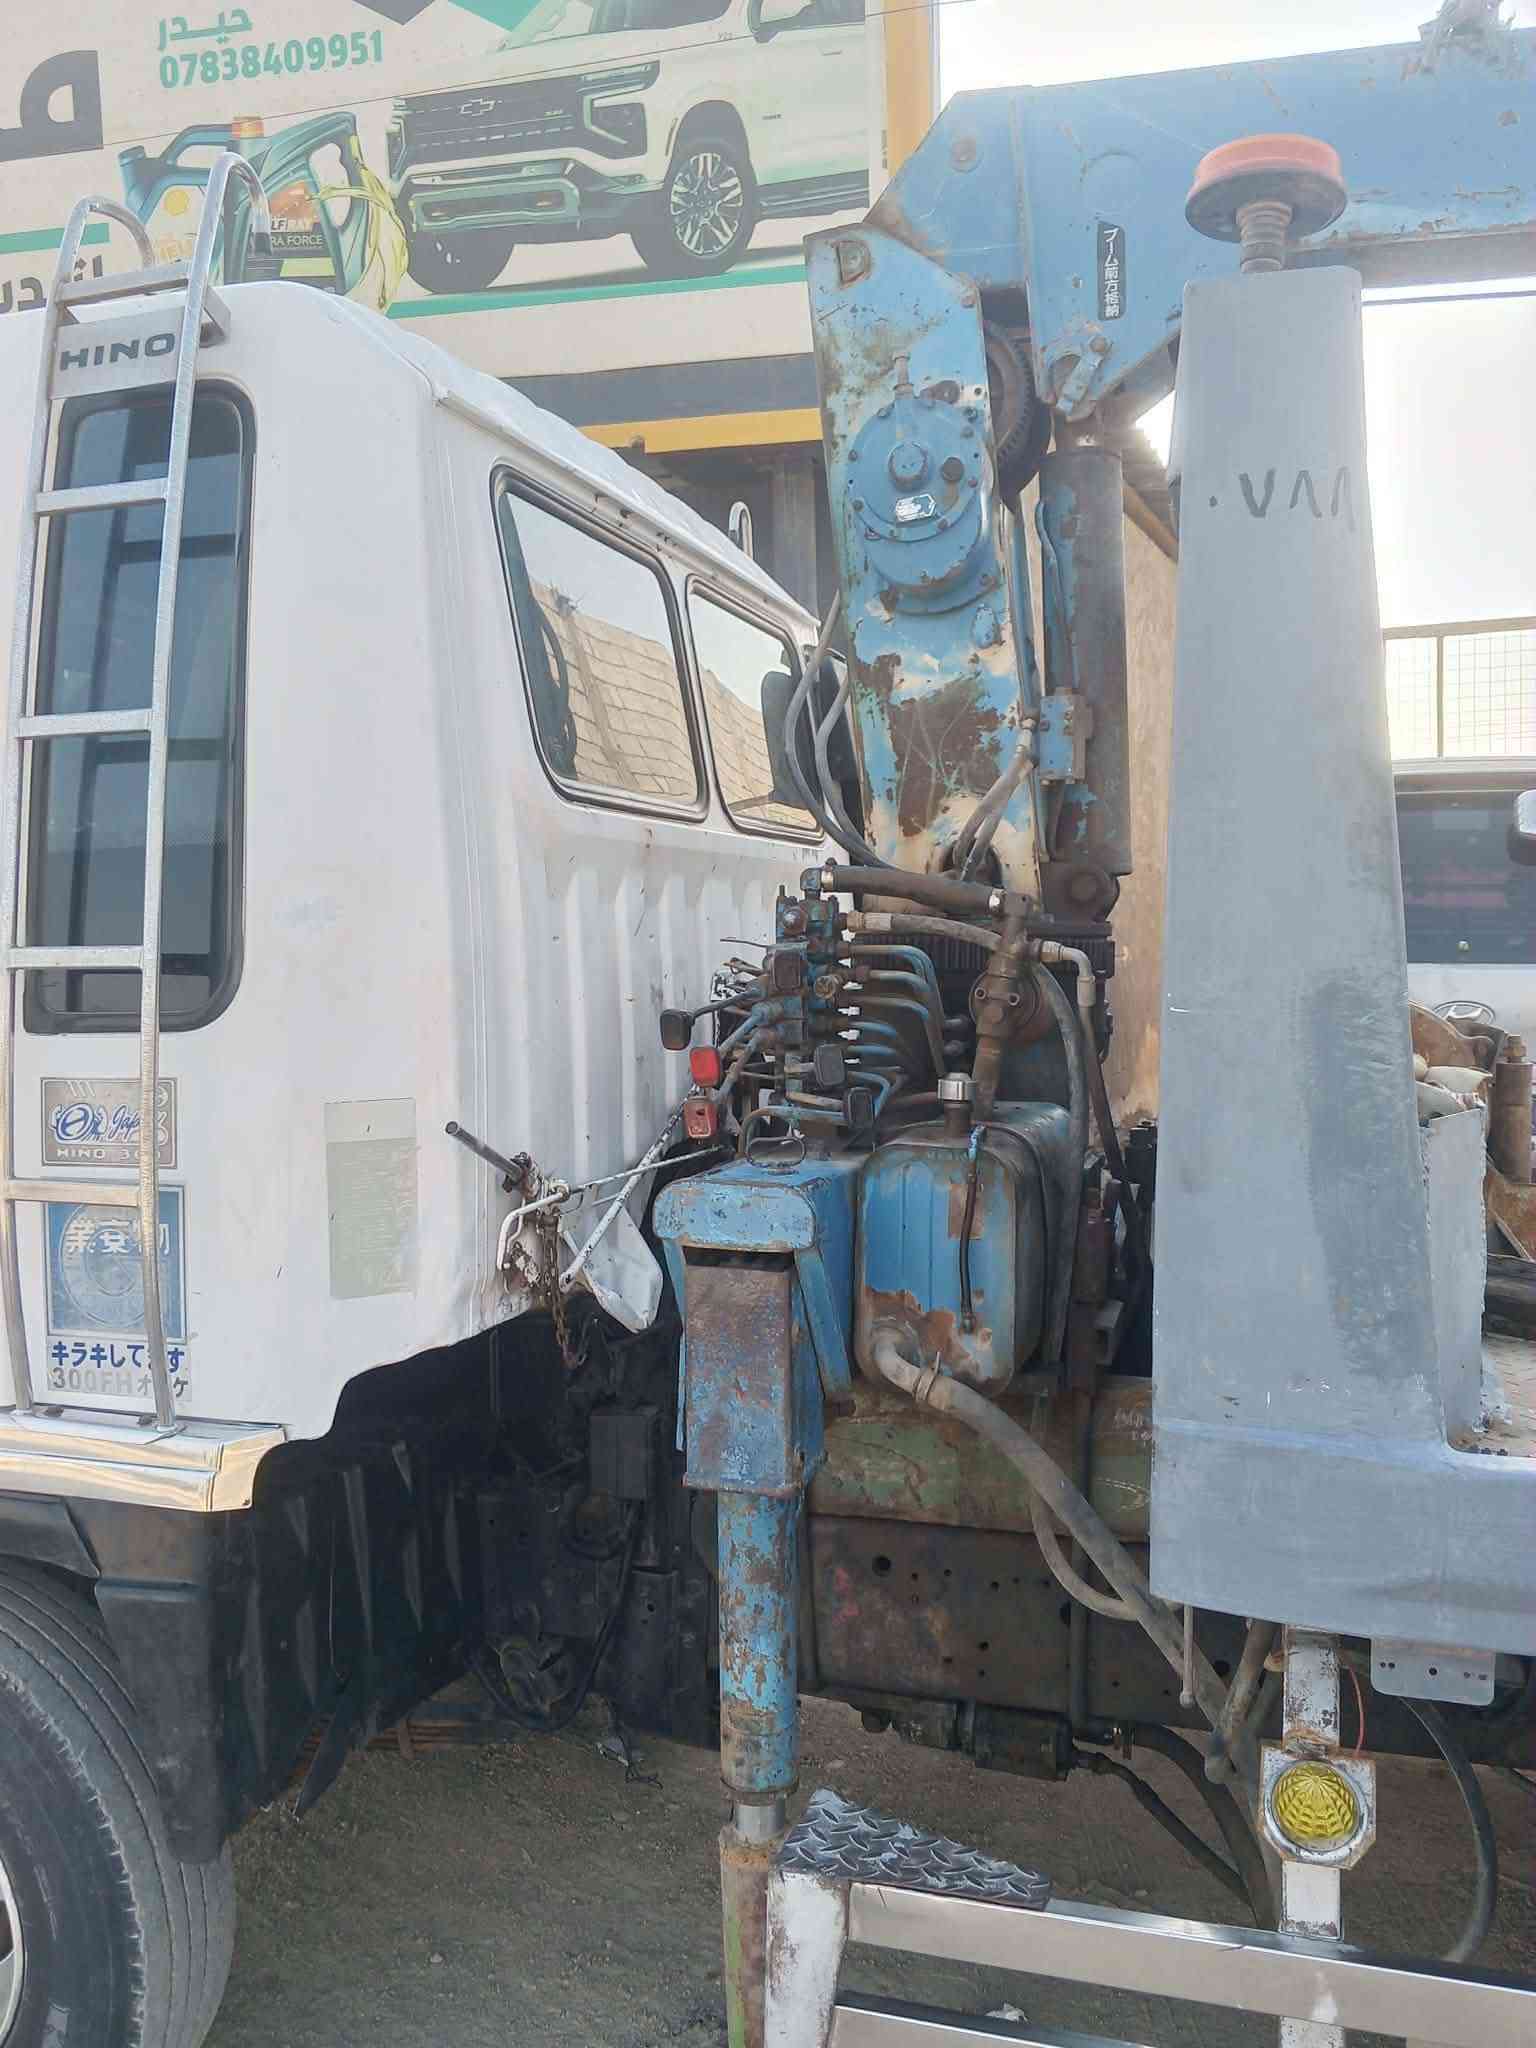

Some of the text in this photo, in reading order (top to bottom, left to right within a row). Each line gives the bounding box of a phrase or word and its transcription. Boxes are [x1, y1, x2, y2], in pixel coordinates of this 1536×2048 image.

[159, 30, 383, 88] 07838409951
[60, 333, 176, 371] HINO
[51, 1341, 185, 1373] キラキしてす
